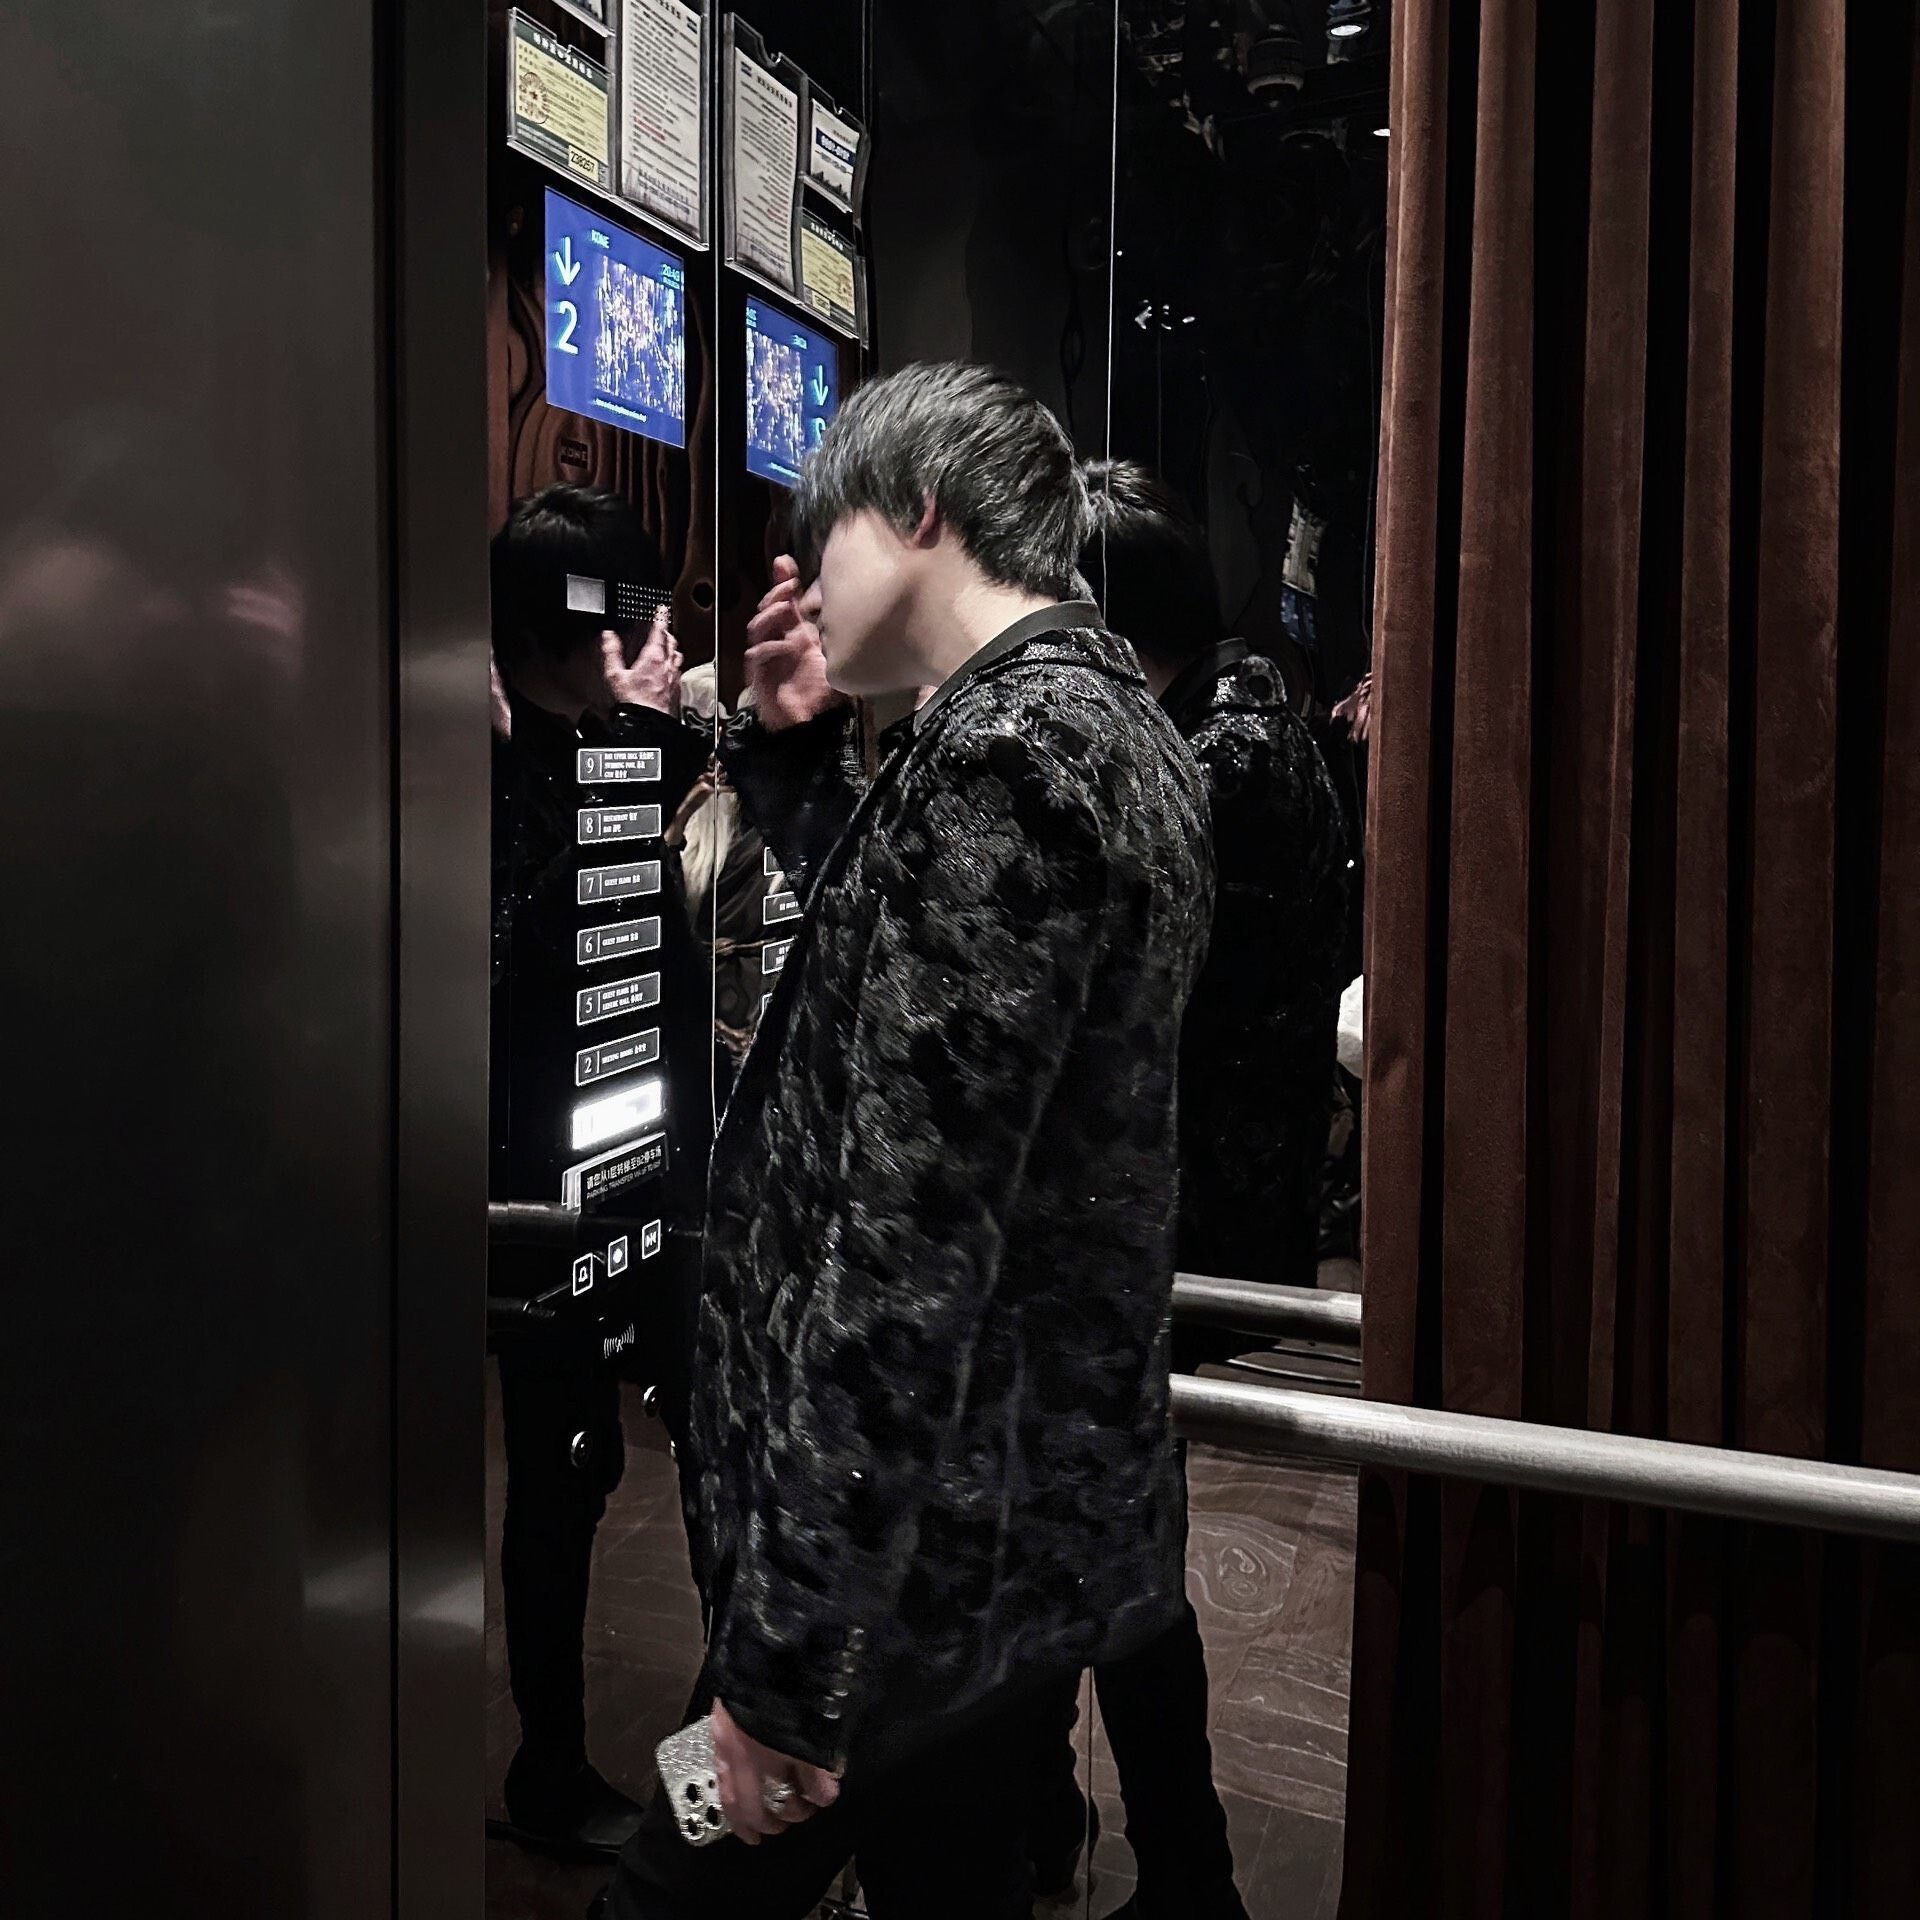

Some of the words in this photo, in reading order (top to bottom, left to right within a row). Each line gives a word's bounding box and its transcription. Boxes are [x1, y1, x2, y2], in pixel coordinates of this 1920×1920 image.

[558, 300, 579, 355] 2
[585, 757, 595, 774] 9
[586, 817, 594, 834] 8
[586, 876, 595, 894] 7
[585, 936, 593, 954] 6
[585, 996, 593, 1014] 5
[584, 1056, 592, 1074] 2
